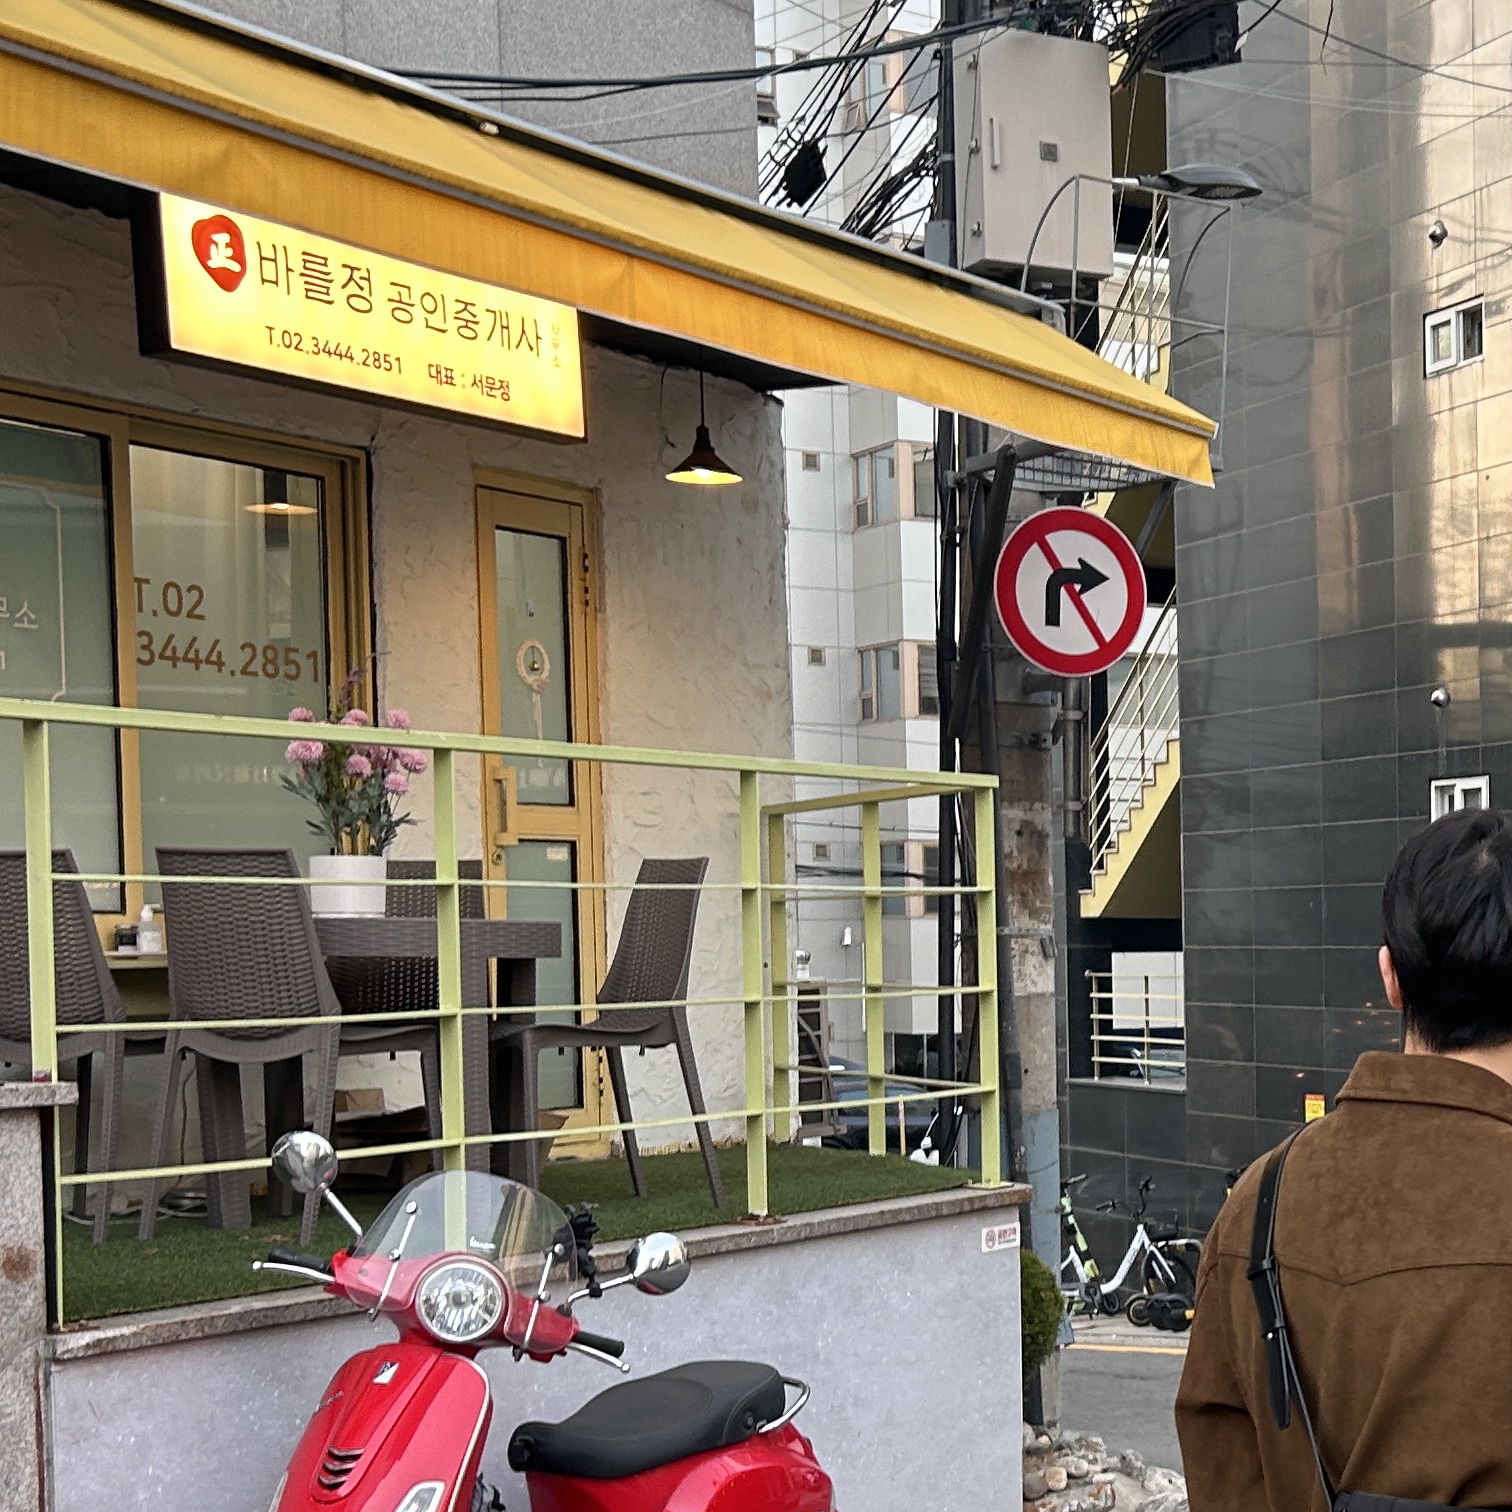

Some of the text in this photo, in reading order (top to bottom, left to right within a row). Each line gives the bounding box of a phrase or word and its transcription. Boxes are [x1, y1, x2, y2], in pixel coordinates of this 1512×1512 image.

[207, 232, 242, 273] 正
[256, 240, 542, 358] 바를정 공인중개사
[264, 325, 402, 375] T.02.3444.2851
[427, 363, 457, 386] 대표
[471, 374, 511, 402] 서문정
[133, 576, 206, 621] T.02
[136, 629, 320, 683] 3444.2851
